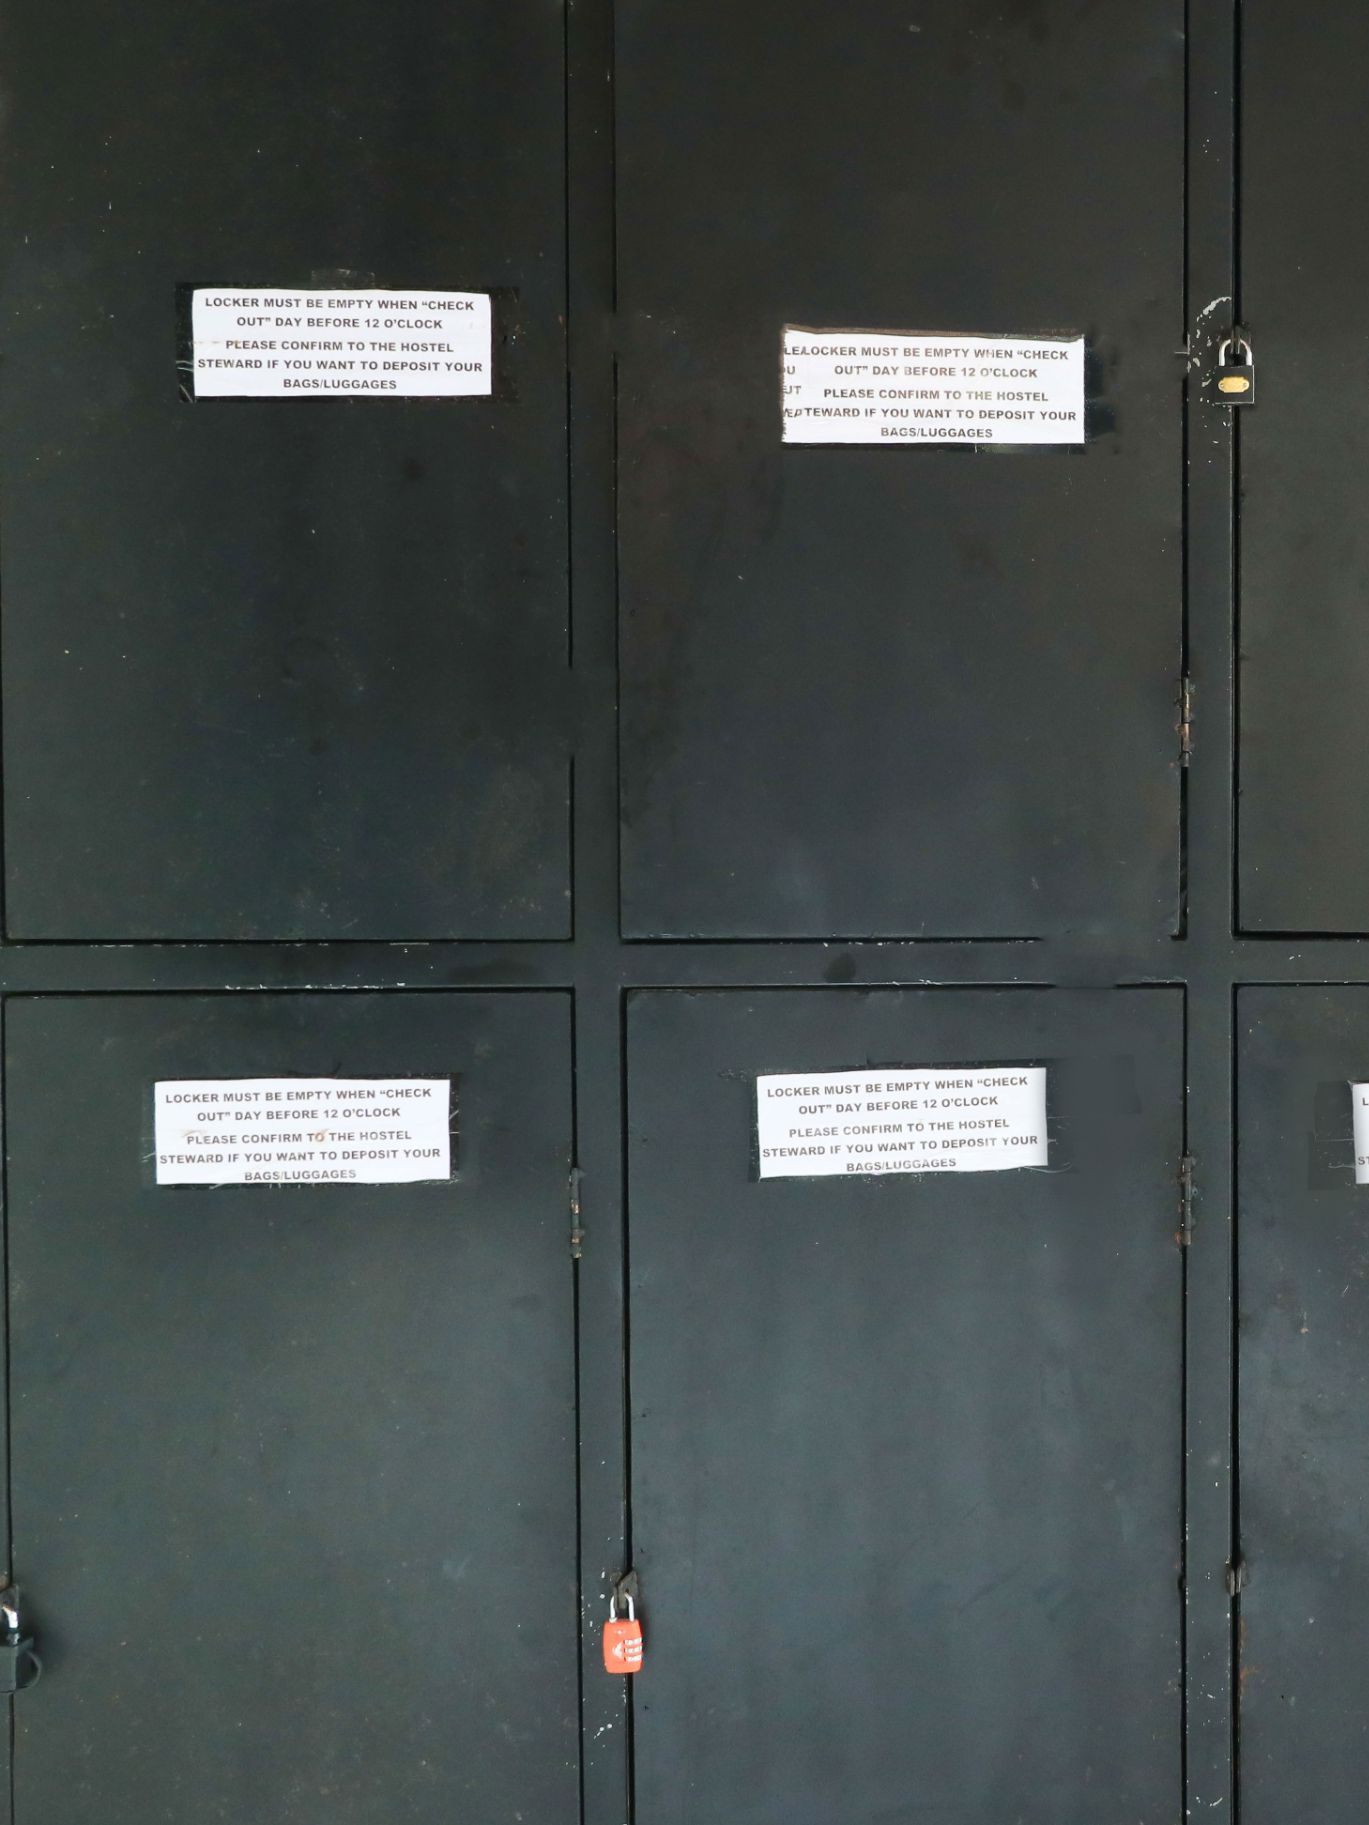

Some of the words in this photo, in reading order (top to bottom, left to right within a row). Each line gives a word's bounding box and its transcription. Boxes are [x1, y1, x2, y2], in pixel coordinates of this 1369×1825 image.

[204, 297, 260, 307] LOCKER
[263, 298, 302, 308] MUST
[306, 298, 323, 308] BE
[327, 299, 373, 309] EMPTY
[377, 299, 418, 310] WHEN
[274, 317, 302, 327] DAY
[306, 317, 360, 328] BEFORE
[364, 318, 380, 328] 12
[225, 340, 277, 350] PLEASE
[280, 340, 343, 351] CONFIRM
[346, 341, 365, 351] TO
[368, 341, 396, 351] THE
[400, 342, 454, 352] HOSTEL
[860, 347, 899, 357] MUST
[902, 347, 920, 357] BE
[924, 347, 970, 358] EMPTY
[197, 358, 263, 369] STEWARD
[266, 359, 279, 369] IF
[283, 359, 312, 370] YOU
[315, 360, 356, 370] WANT
[359, 360, 378, 370] TO
[382, 361, 440, 371] DEPOSIT
[444, 362, 483, 372] YOUR
[872, 365, 900, 376] DAY
[903, 366, 956, 376] BEFORE
[960, 367, 976, 377] 12
[282, 378, 397, 389] BAGS/LUGGAGES
[823, 388, 875, 398] PLEASE
[878, 389, 940, 399] CONFIRM
[943, 390, 962, 400] TO
[965, 391, 992, 400] THE
[996, 391, 1049, 402] HOSTEL
[766, 1086, 820, 1098] LOCKER
[823, 1084, 861, 1095] MUST
[864, 1083, 882, 1093] BE
[885, 1081, 930, 1092] EMPTY
[934, 1079, 973, 1090] WHEN
[165, 1093, 219, 1103] LOCKER
[223, 1092, 261, 1102] MUST
[264, 1091, 282, 1101] BE
[286, 1090, 332, 1101] EMPTY
[335, 1089, 376, 1099] WHEN
[835, 1103, 862, 1113] DAY
[866, 1100, 918, 1111] BEFORE
[922, 1099, 937, 1108] 12
[234, 1111, 262, 1121] DAY
[265, 1109, 319, 1120] BEFORE
[323, 1109, 338, 1118] 12
[788, 1126, 839, 1138] PLEASE
[842, 1123, 903, 1135] CONFIRM
[906, 1122, 925, 1132] TO
[927, 1121, 954, 1131] THE
[958, 1118, 1010, 1129] HOSTEL
[186, 1134, 237, 1145] PLEASE
[241, 1133, 302, 1144] CONFIRM
[306, 1132, 325, 1142] TO
[328, 1131, 355, 1142] THE
[359, 1130, 412, 1140] HOSTEL
[762, 1145, 826, 1158] STEWARD
[829, 1145, 841, 1154] IF
[845, 1143, 873, 1153] YOU
[876, 1141, 915, 1152] WANT
[919, 1140, 938, 1150] TO
[941, 1137, 997, 1149] DEPOSIT
[1002, 1135, 1038, 1146] YOUR
[159, 1154, 224, 1164] STEWARD
[227, 1153, 239, 1163] IF
[243, 1153, 272, 1162] YOU
[275, 1151, 315, 1161] WANT
[318, 1151, 338, 1160] TO
[341, 1149, 399, 1160] DEPOSIT
[402, 1148, 441, 1158] YOUR
[244, 1169, 357, 1181] BAGS/LUGGAGES
